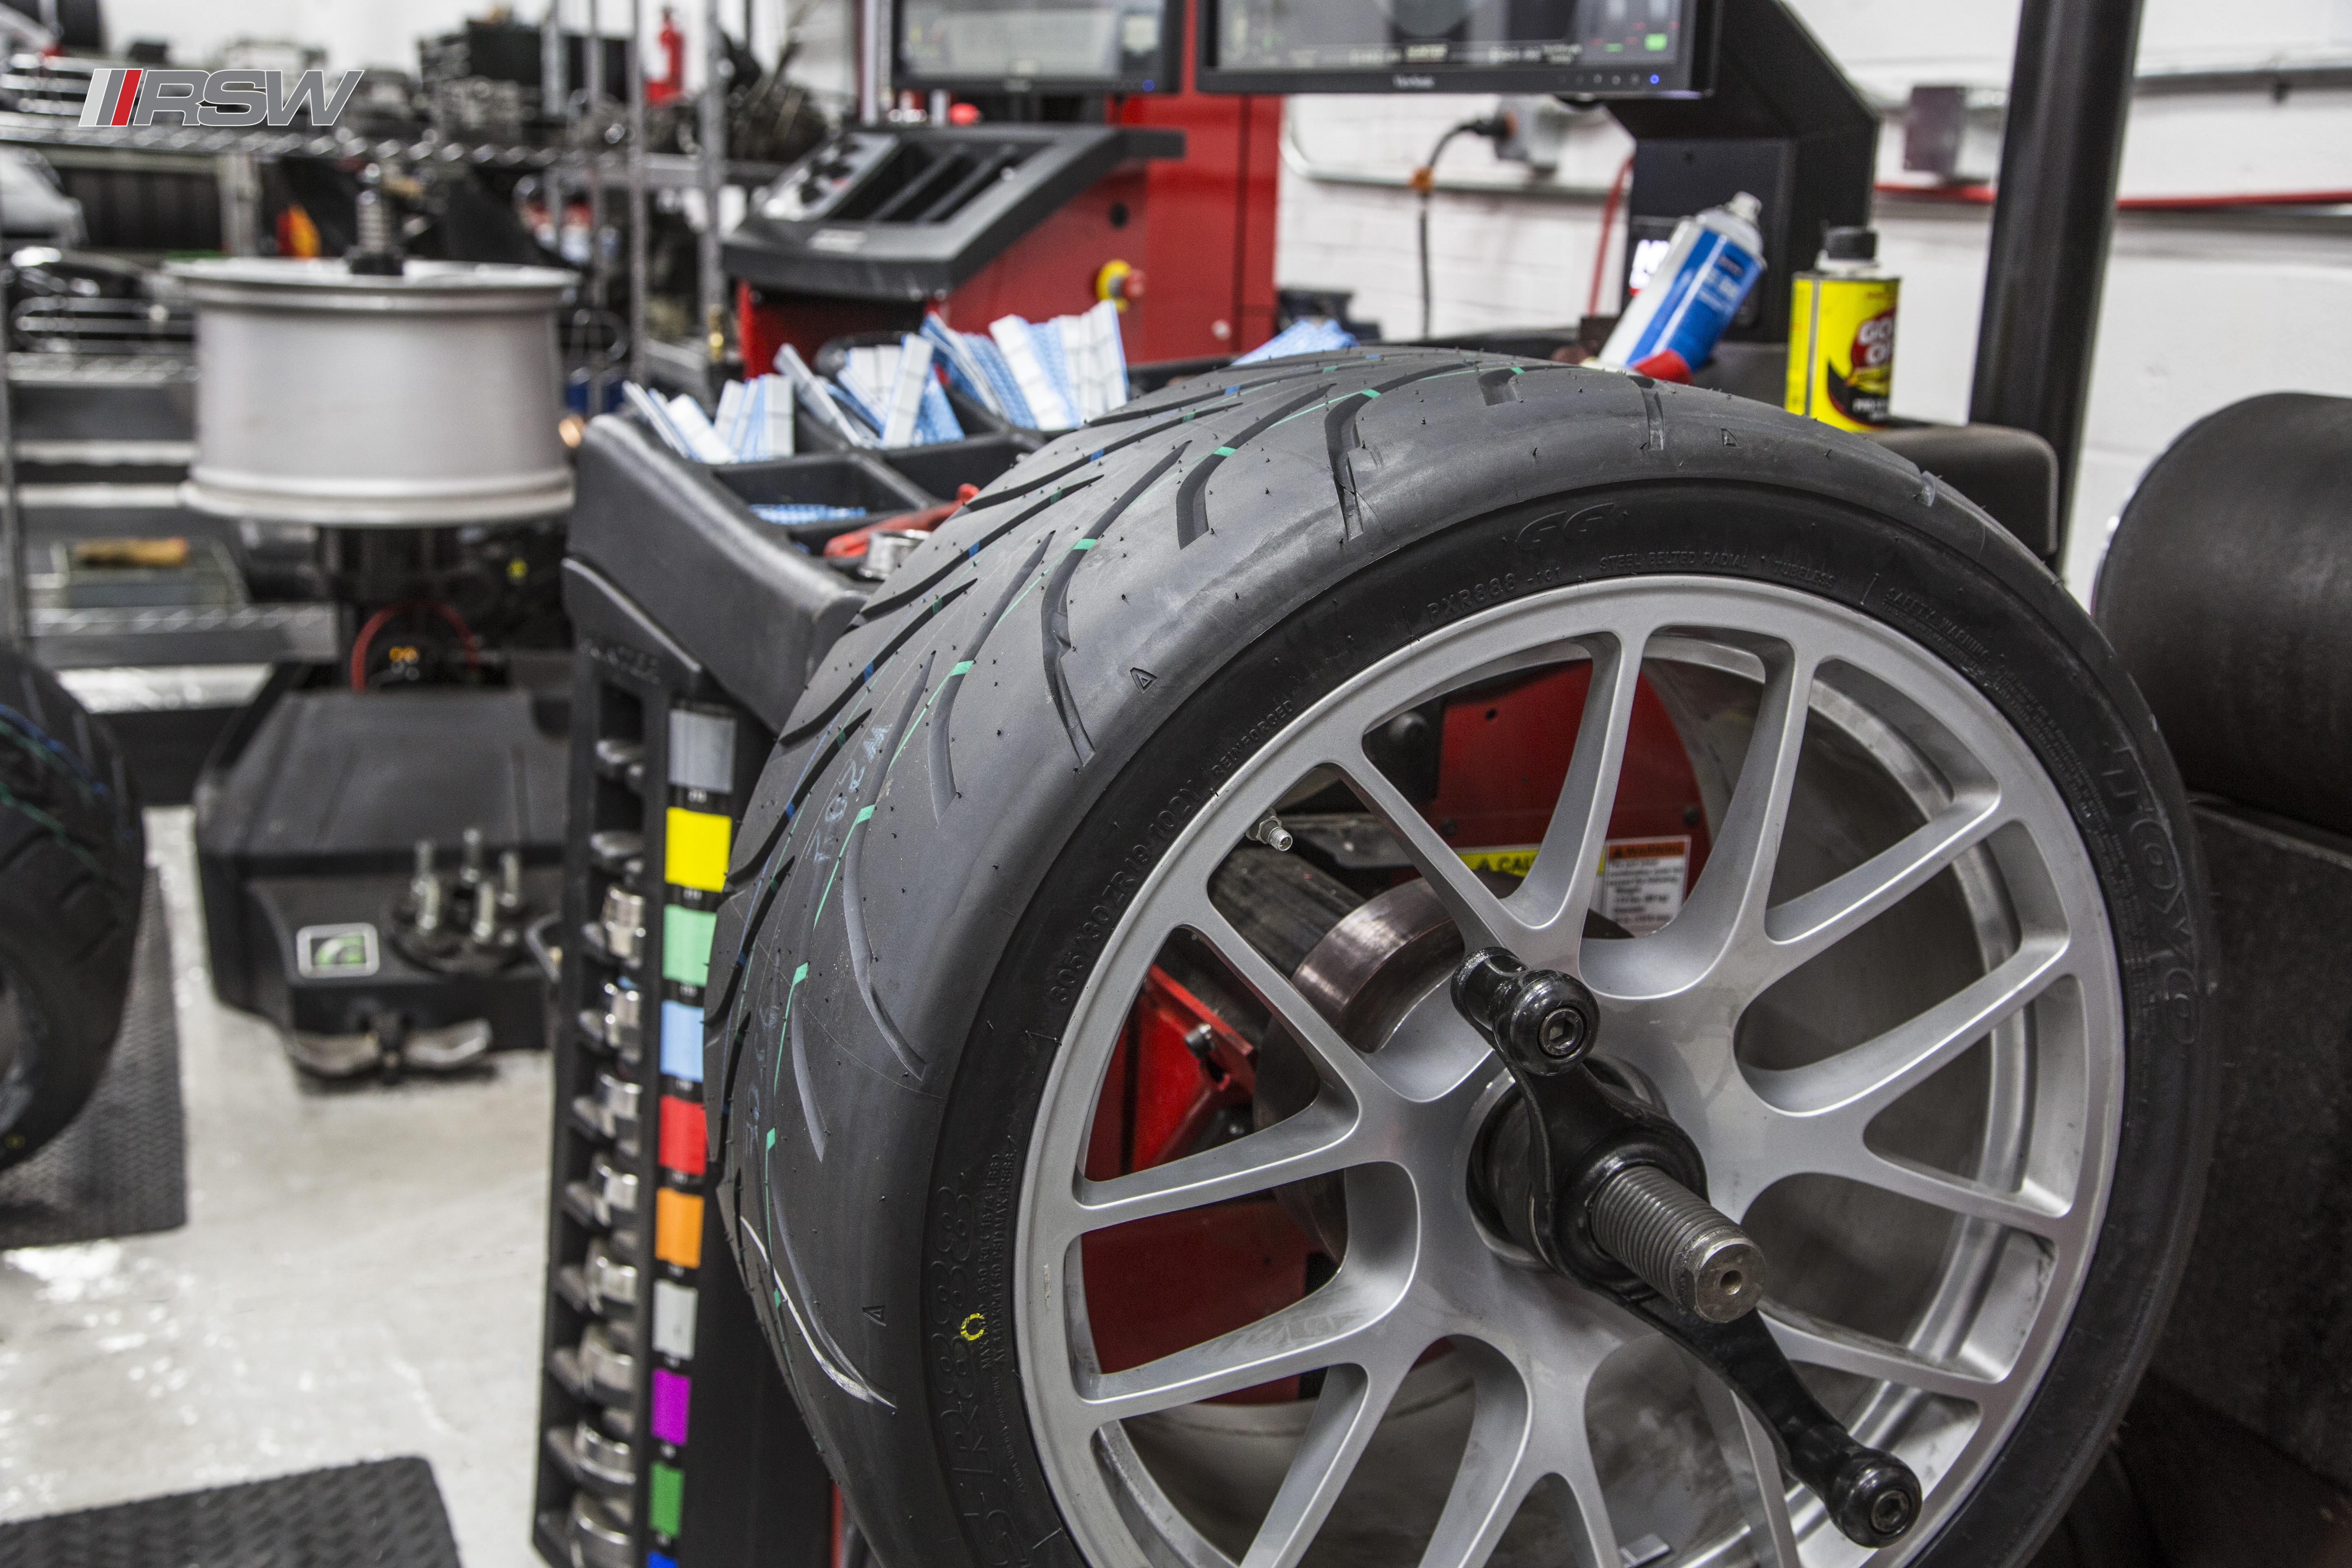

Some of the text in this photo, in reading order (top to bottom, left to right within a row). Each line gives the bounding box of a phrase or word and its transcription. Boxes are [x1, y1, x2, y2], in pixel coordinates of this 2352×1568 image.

[1599, 550, 1749, 571] STEEL BELTED RADIAL
[1426, 572, 1517, 623] PXR888
[1211, 699, 1295, 777] REINFORCED
